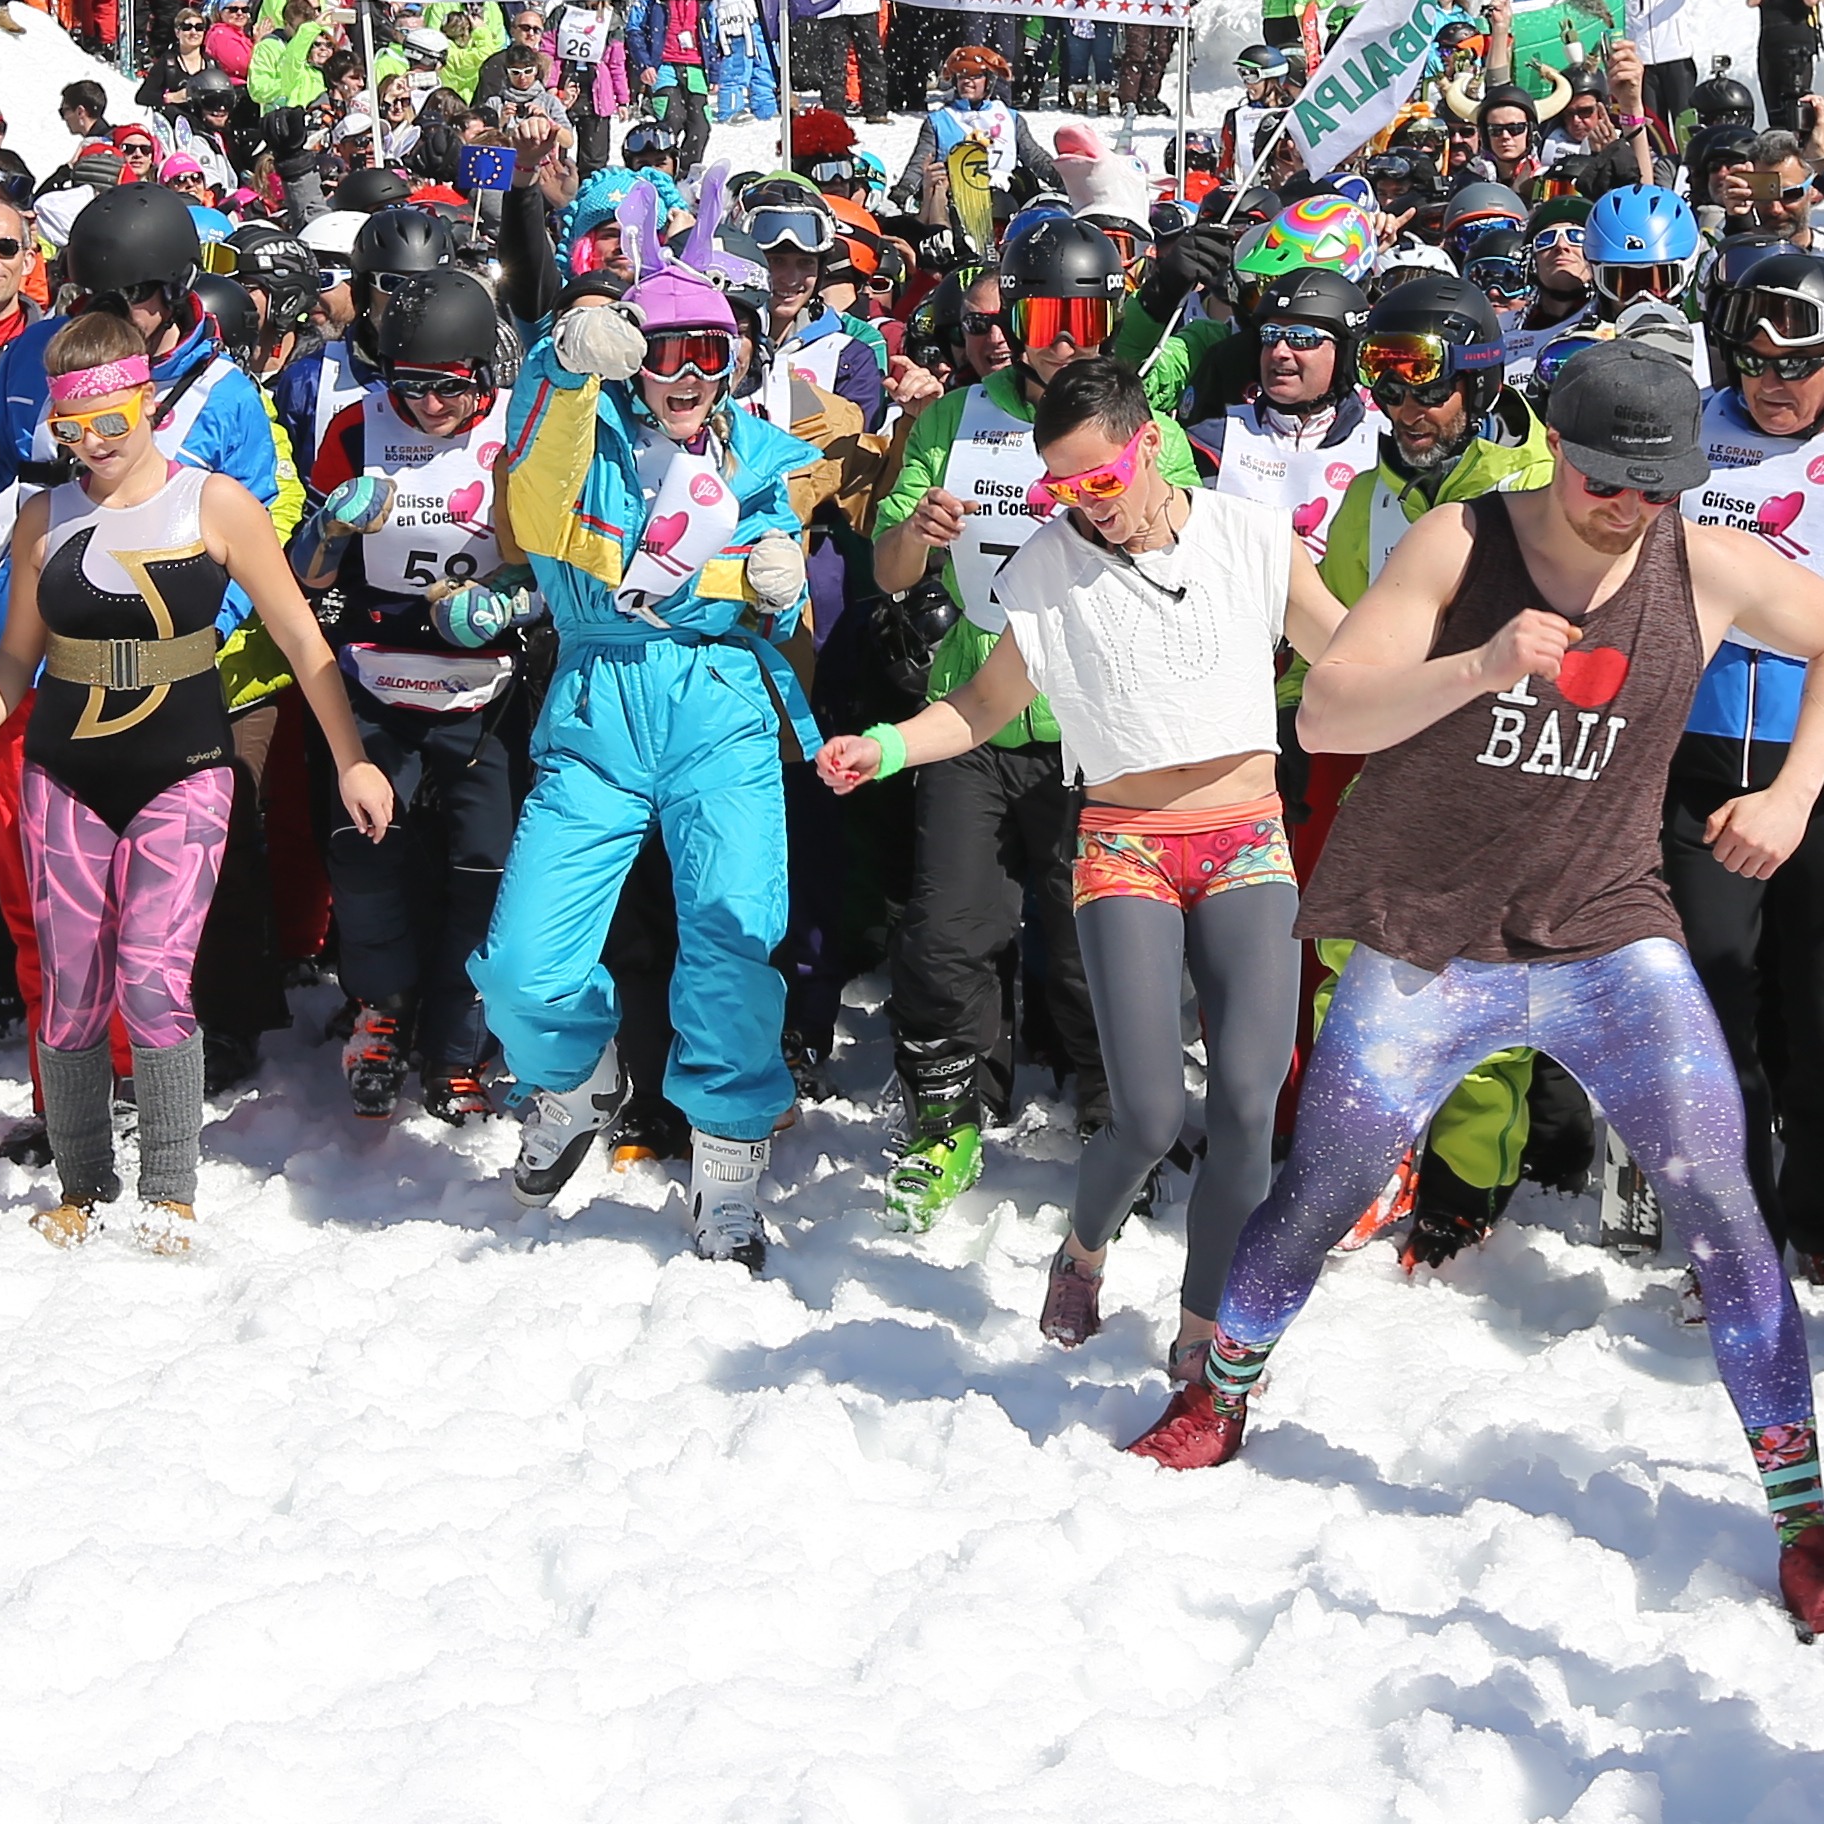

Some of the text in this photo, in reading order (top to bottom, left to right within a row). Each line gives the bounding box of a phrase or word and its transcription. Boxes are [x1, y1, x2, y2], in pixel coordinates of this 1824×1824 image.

[566, 39, 591, 58] 26
[385, 445, 435, 454] LE GRAND
[385, 453, 435, 462] BORNAND
[1709, 444, 1764, 460] LE GRAND
[1240, 452, 1287, 470] LE GRAND
[1707, 453, 1761, 467] BORNAND
[1239, 461, 1287, 478] BORNAND
[974, 479, 1023, 498] Glisse
[396, 494, 444, 510] Glisse
[998, 500, 1046, 517] Coeur
[1702, 490, 1755, 515] Glisse
[396, 509, 469, 527] en Coeur
[1725, 513, 1780, 535] Coeur
[377, 675, 441, 692] SALOMON
